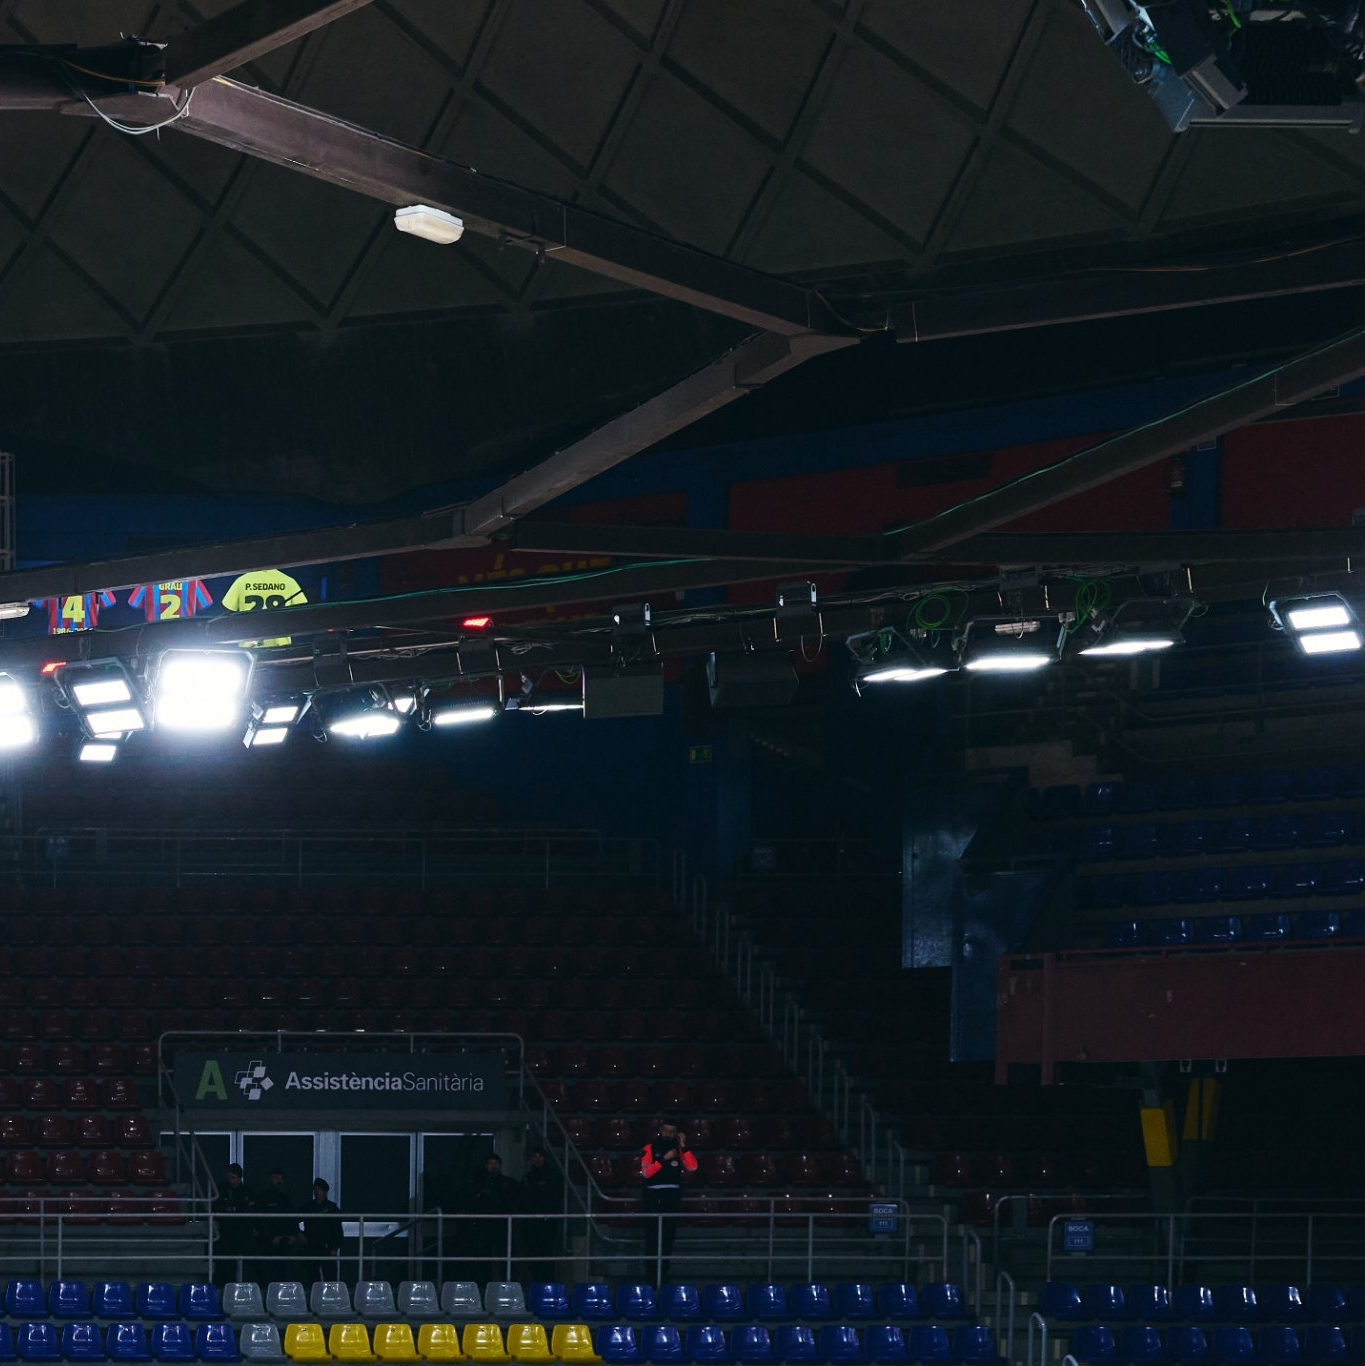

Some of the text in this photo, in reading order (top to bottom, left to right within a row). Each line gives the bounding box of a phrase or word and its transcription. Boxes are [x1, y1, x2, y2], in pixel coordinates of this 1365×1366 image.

[62, 596, 85, 622] 4
[160, 595, 181, 619] 2
[195, 1060, 228, 1100] A
